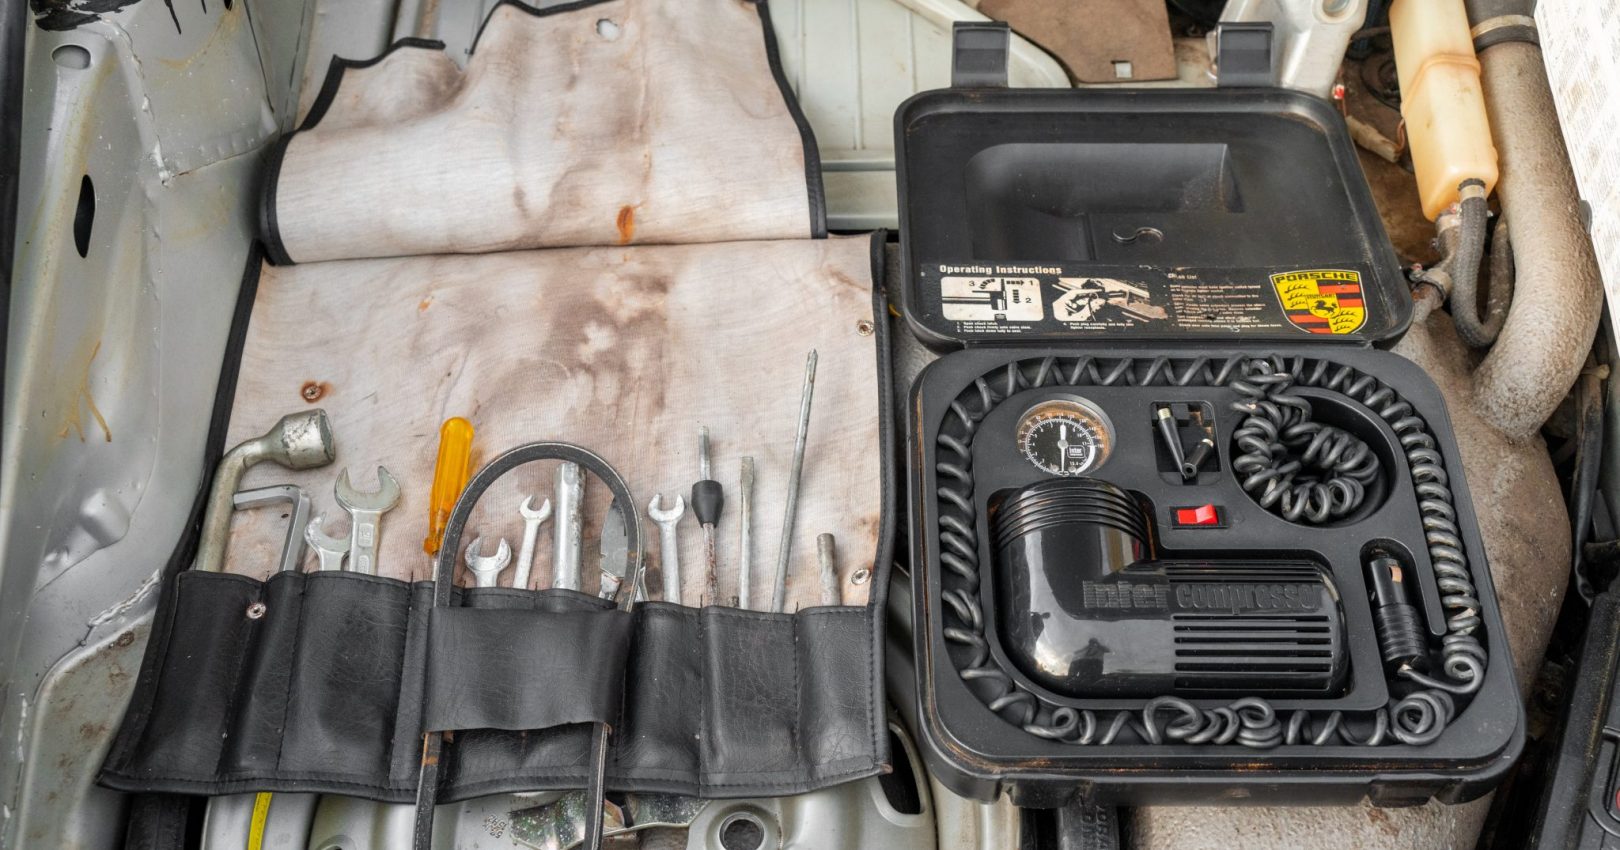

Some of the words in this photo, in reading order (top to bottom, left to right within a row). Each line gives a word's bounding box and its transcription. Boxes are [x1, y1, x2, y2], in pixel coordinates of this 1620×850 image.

[939, 265, 993, 275] Operating
[996, 265, 1062, 275] Instructions
[1275, 272, 1356, 284] PORSCHE
[1082, 580, 1171, 609] Inter
